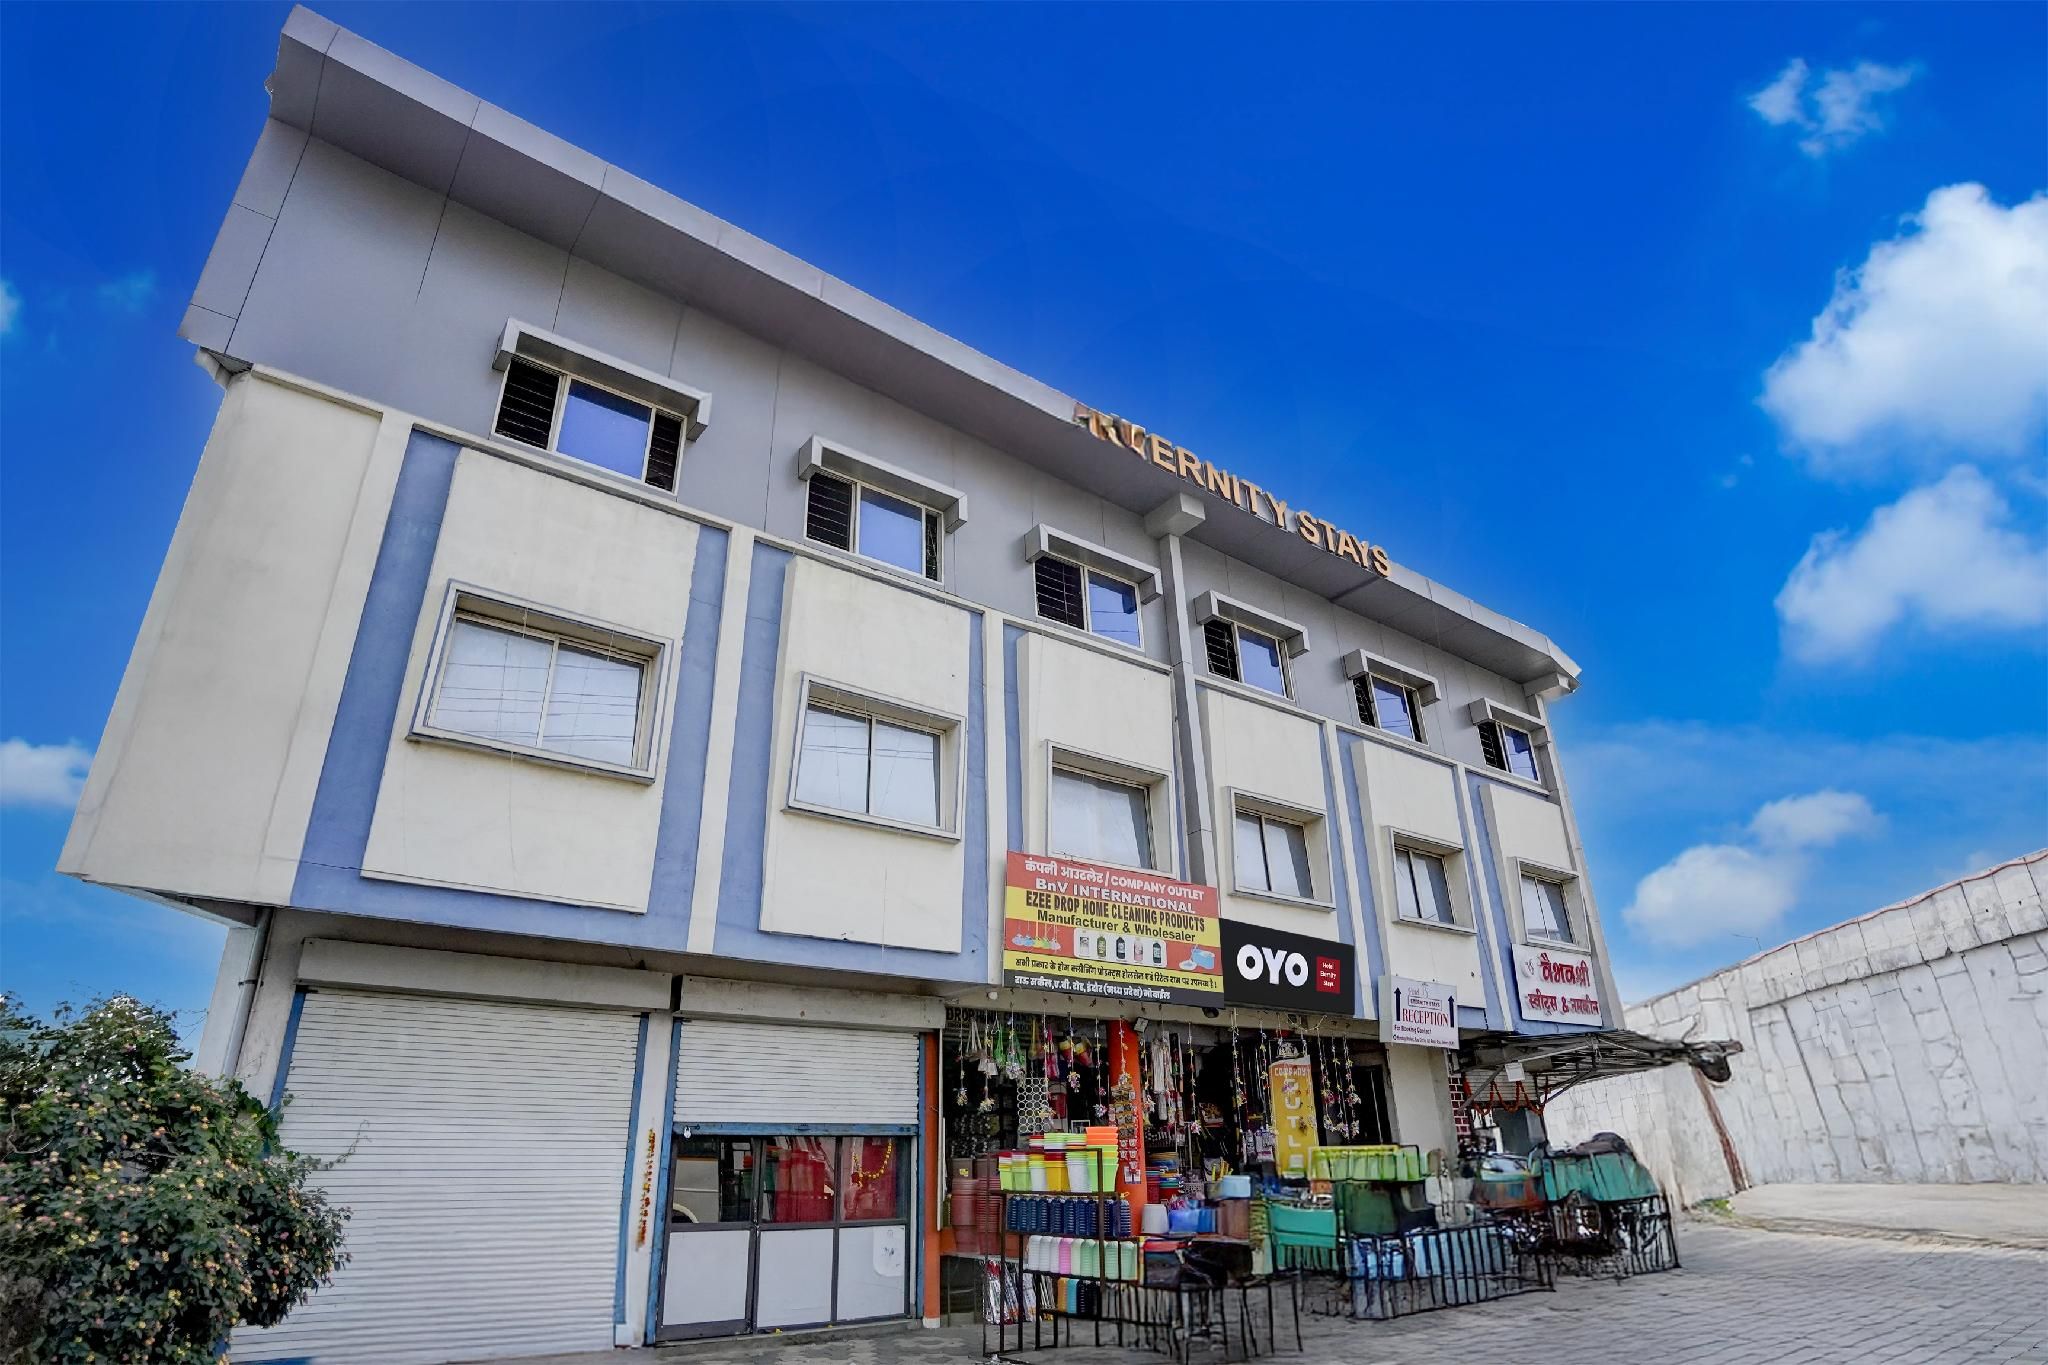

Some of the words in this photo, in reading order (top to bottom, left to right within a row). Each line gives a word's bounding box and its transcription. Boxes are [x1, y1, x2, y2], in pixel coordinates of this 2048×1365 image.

[1297, 511, 1391, 578] STAYS
[1035, 878, 1068, 894] BnV
[1073, 884, 1196, 913] INTERNATIONAL
[1111, 875, 1166, 894] COMPANY
[1167, 885, 1205, 901] OUTLET
[1026, 890, 1051, 909] EZEE
[1054, 895, 1080, 912] DROP
[1082, 899, 1109, 918] HOME
[1112, 903, 1157, 925] CLEANING
[1159, 911, 1205, 932] PRODUCTS
[1037, 910, 1118, 931] Manufacturer
[1122, 922, 1131, 933] &
[1135, 924, 1196, 942] Wholesaler
[1016, 957, 1029, 967] सभी
[1050, 959, 1056, 969] के
[1237, 944, 1308, 987] OYO
[1402, 1008, 1449, 1026] RECEPTION
[1561, 996, 1569, 1012] &
